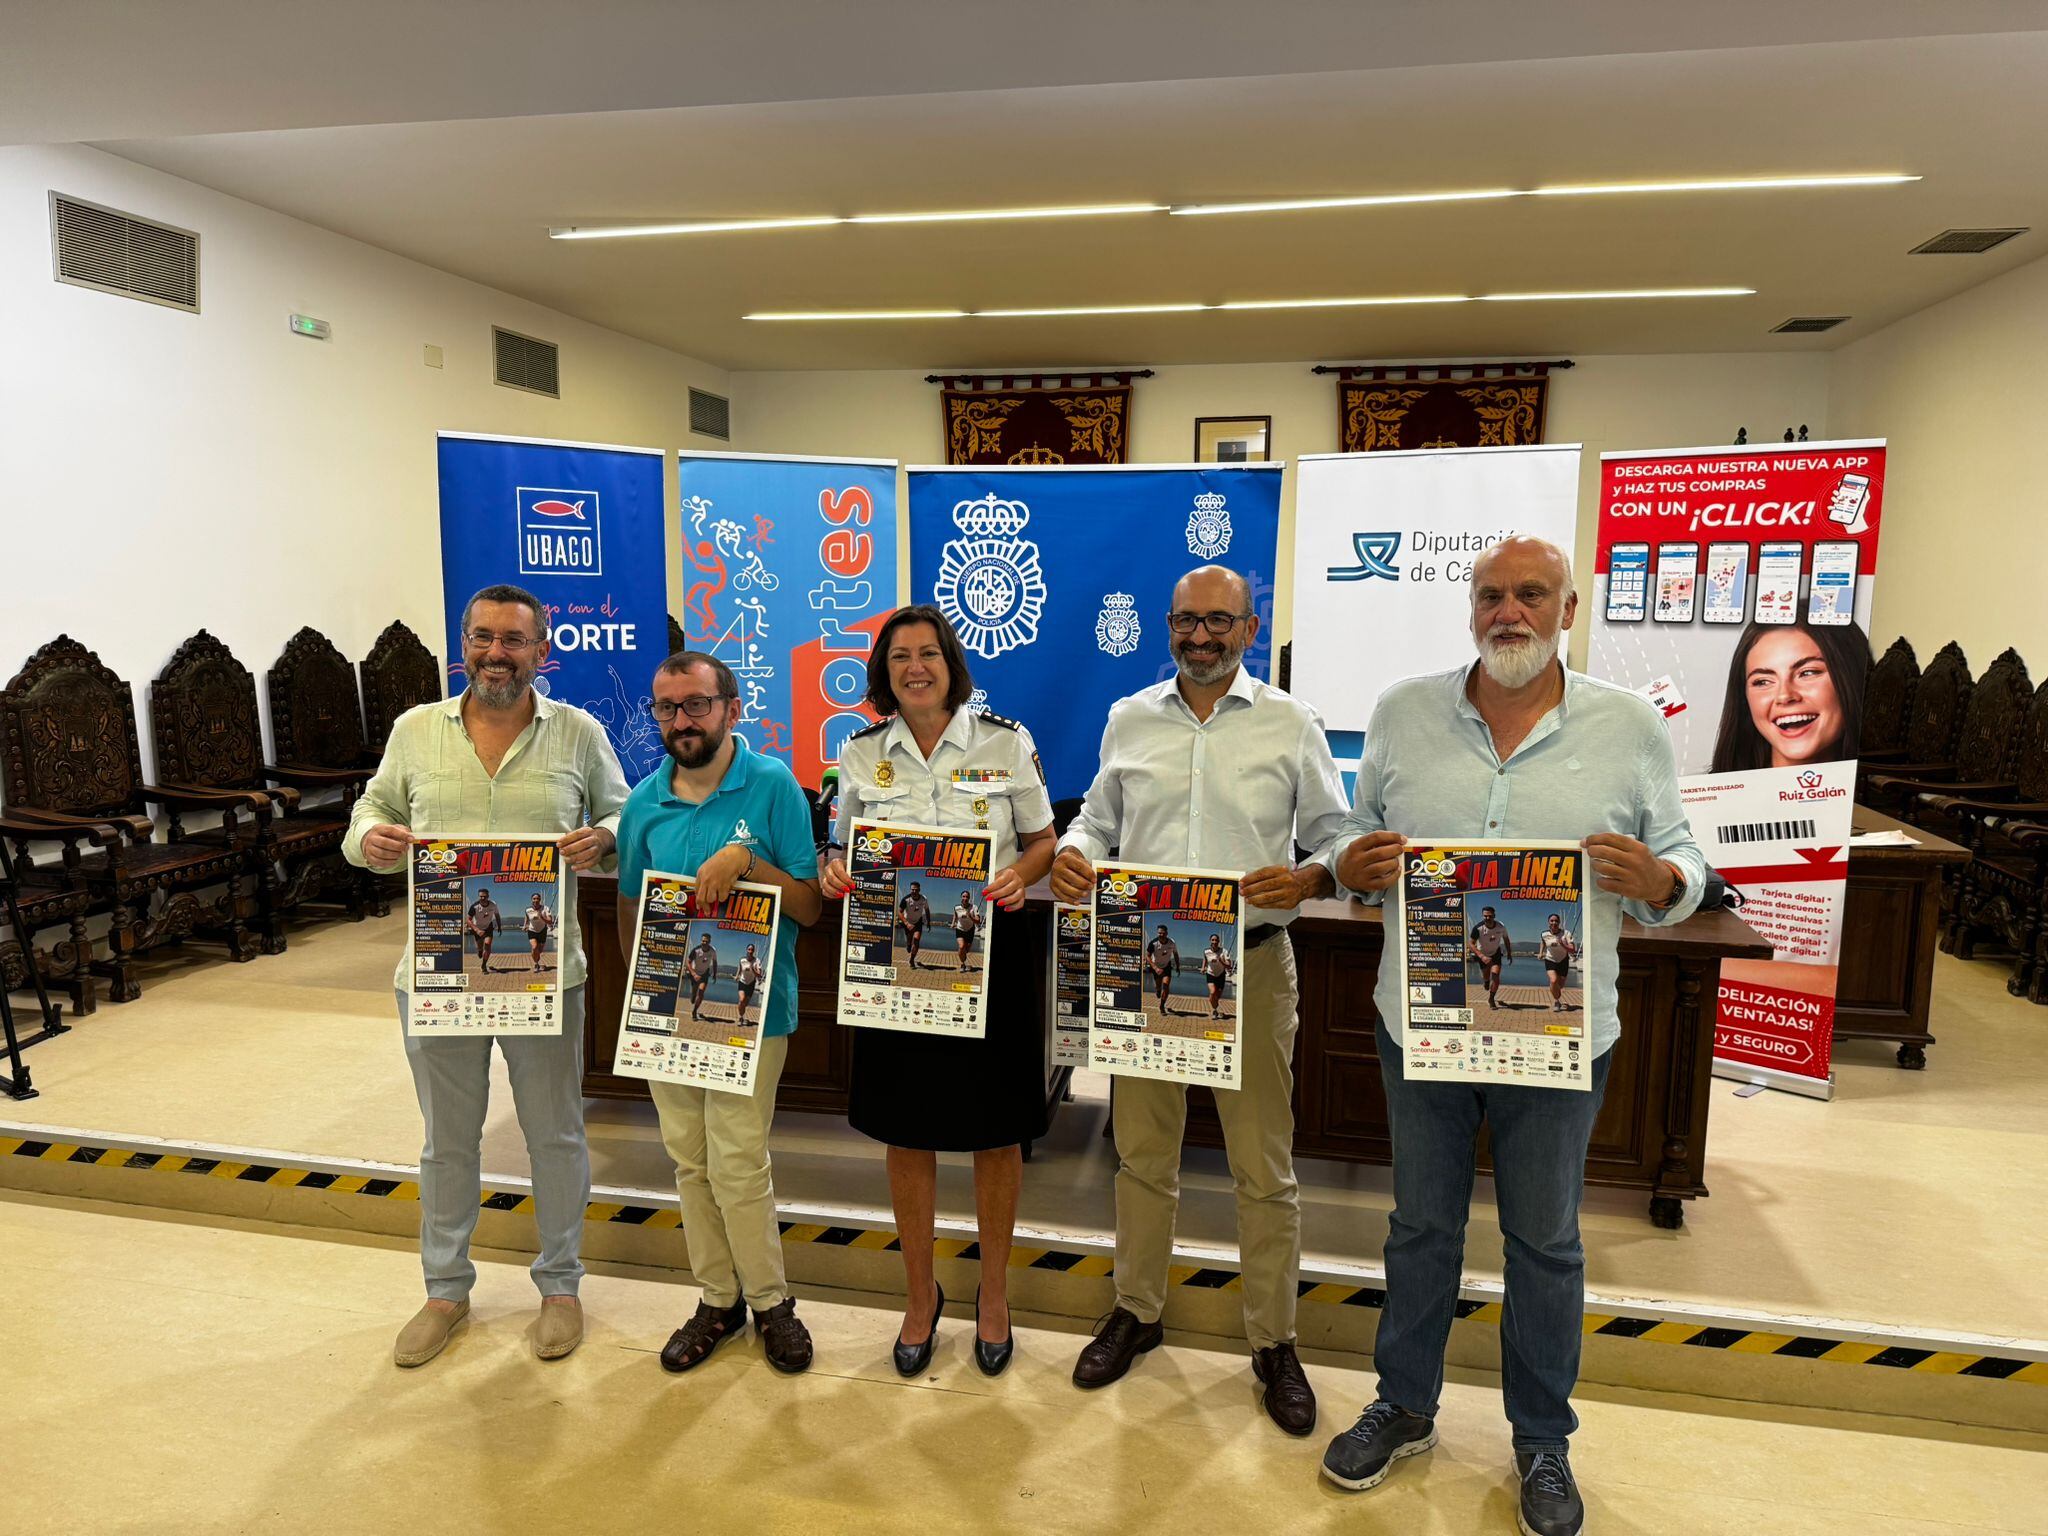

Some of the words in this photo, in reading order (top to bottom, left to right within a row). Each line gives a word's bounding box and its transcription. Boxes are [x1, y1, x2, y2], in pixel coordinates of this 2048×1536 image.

[1615, 464, 1693, 478] DESCARGA
[1698, 461, 1769, 475] NUESTRA
[1773, 459, 1829, 471] NUEVA
[1832, 457, 1869, 469] APP
[1613, 485, 1621, 496] y
[1624, 482, 1655, 494] HAZ
[1658, 481, 1687, 493] TUS
[1689, 478, 1766, 492] COMPRAS
[1610, 502, 1652, 517] CON
[1658, 501, 1687, 516] UN
[1689, 501, 1816, 532] ¡CLICK!
[527, 534, 593, 567] UBAGO
[1412, 530, 1515, 555] Diputaci
[960, 560, 981, 584] CUERPO
[983, 558, 1015, 577] NACIONAL
[1012, 574, 1021, 586] DE
[1410, 561, 1436, 582] de
[1446, 561, 1472, 582] Cá
[542, 603, 560, 628] go
[568, 602, 594, 614] con
[600, 592, 620, 618] el
[1680, 787, 1706, 795] TARJETA
[1707, 783, 1745, 792] FIDELIZADO
[1779, 789, 1804, 801] Ruiz
[1806, 786, 1847, 799] Galán
[856, 838, 893, 854] 200
[904, 844, 925, 867] LA
[934, 838, 985, 868] LÍNEA
[419, 850, 458, 864] 200
[470, 851, 492, 873] LA
[501, 843, 553, 871] LÍNEA
[1411, 859, 1456, 876] 200
[1472, 861, 1498, 888] LA
[1509, 852, 1574, 886] LÍNEA
[651, 888, 688, 904] 200
[1101, 880, 1138, 896] 200
[1150, 885, 1171, 909] LA
[1180, 880, 1232, 911] LÍNEA
[1512, 890, 1518, 898] la
[1520, 886, 1578, 901] CONCEPCIÓN
[1761, 888, 1792, 899] Tarjeta
[1795, 893, 1825, 903] digital
[725, 893, 772, 923] LÍNEA
[1734, 895, 1773, 907] Cpones
[1775, 900, 1824, 914] descuento
[1414, 911, 1422, 920] 13
[1740, 907, 1773, 918] Ofertas
[1775, 913, 1823, 925] exclusivas
[1744, 918, 1773, 928] grama
[1775, 922, 1787, 930] de
[1789, 925, 1822, 936] puntos
[1773, 943, 1788, 952] ket
[1790, 946, 1820, 957] digital
[1791, 935, 1821, 946] digital
[1717, 986, 1820, 1015] DELIZACIÓN
[1722, 1004, 1814, 1031] VENTAJAS!
[1720, 1033, 1730, 1044] y
[1733, 1034, 1797, 1056] SEGURO
